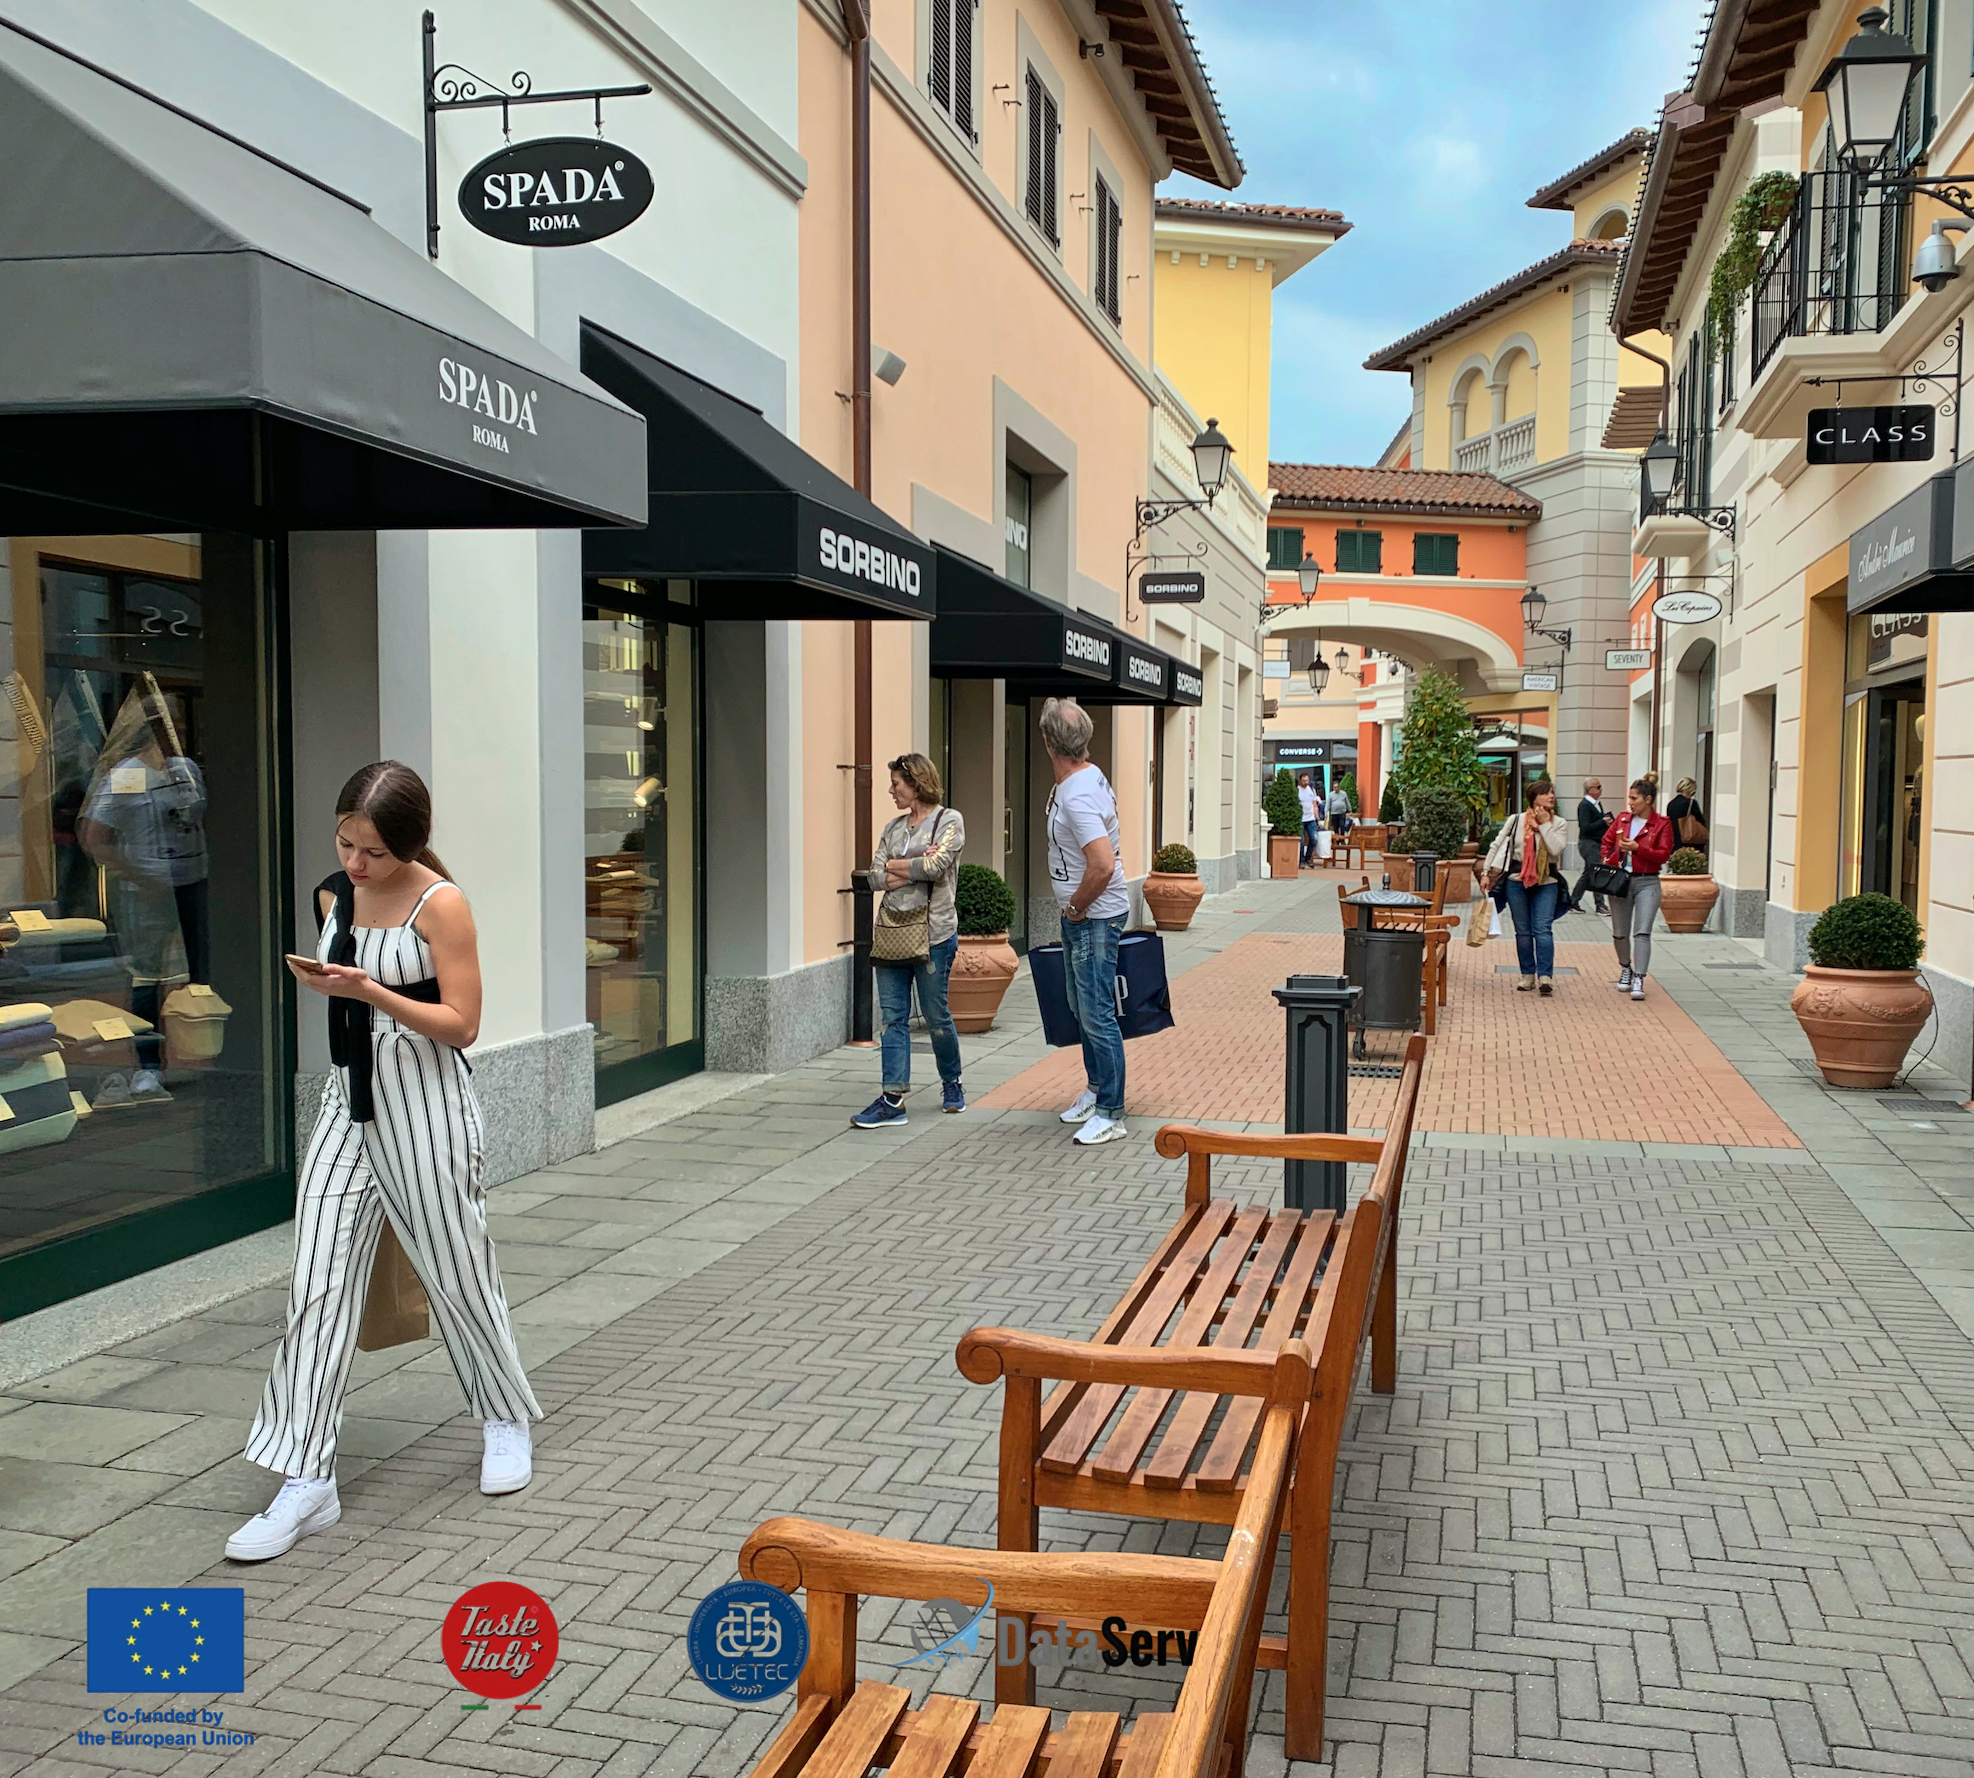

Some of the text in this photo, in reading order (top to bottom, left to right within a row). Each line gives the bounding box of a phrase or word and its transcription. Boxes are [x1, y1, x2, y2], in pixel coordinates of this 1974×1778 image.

[528, 213, 581, 232] ROMA
[472, 424, 510, 454] ROMA
[1815, 425, 1927, 444] CLASS
[819, 527, 921, 597] SORBINO
[1146, 583, 1198, 594] SORBINO
[1661, 600, 1713, 615] Les Copains
[1065, 629, 1110, 666] SORBINO
[1613, 653, 1644, 664] SEVENTY
[1128, 655, 1162, 686] SORBINO
[1176, 671, 1202, 697] SORBINO
[1279, 748, 1316, 756] CONVERSE
